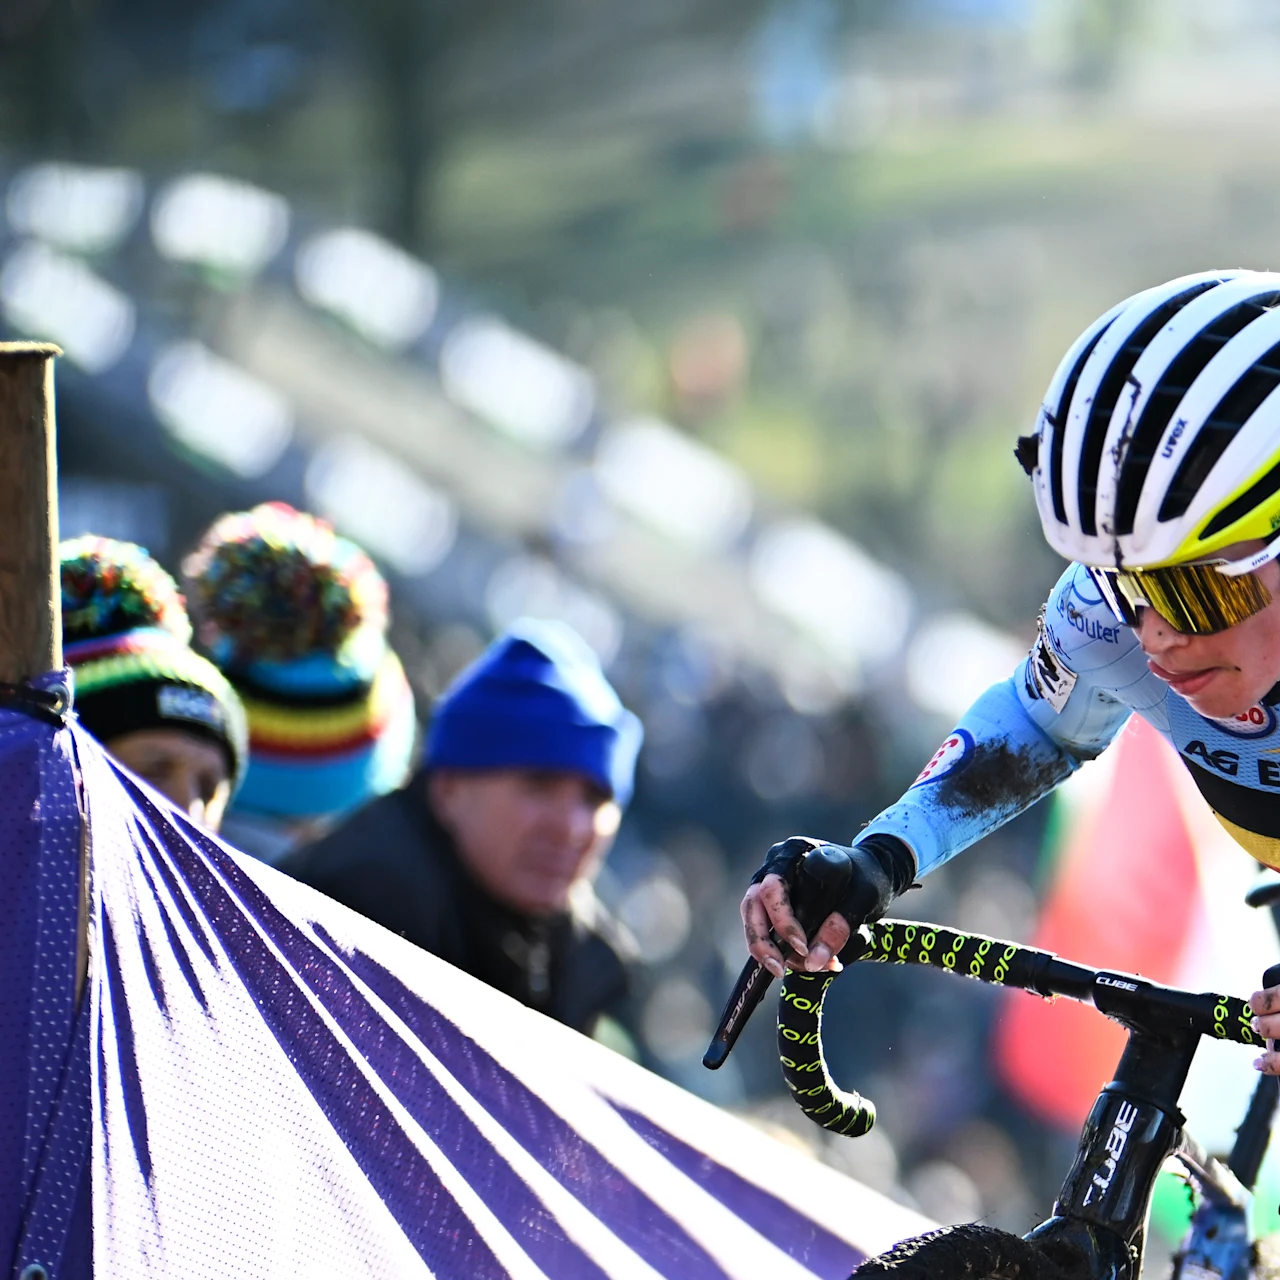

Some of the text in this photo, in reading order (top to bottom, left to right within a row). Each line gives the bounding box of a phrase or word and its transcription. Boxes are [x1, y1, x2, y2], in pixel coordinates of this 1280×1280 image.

[1162, 417, 1187, 458] uvex
[1184, 740, 1240, 777] AG
[1096, 976, 1138, 992] CUBE
